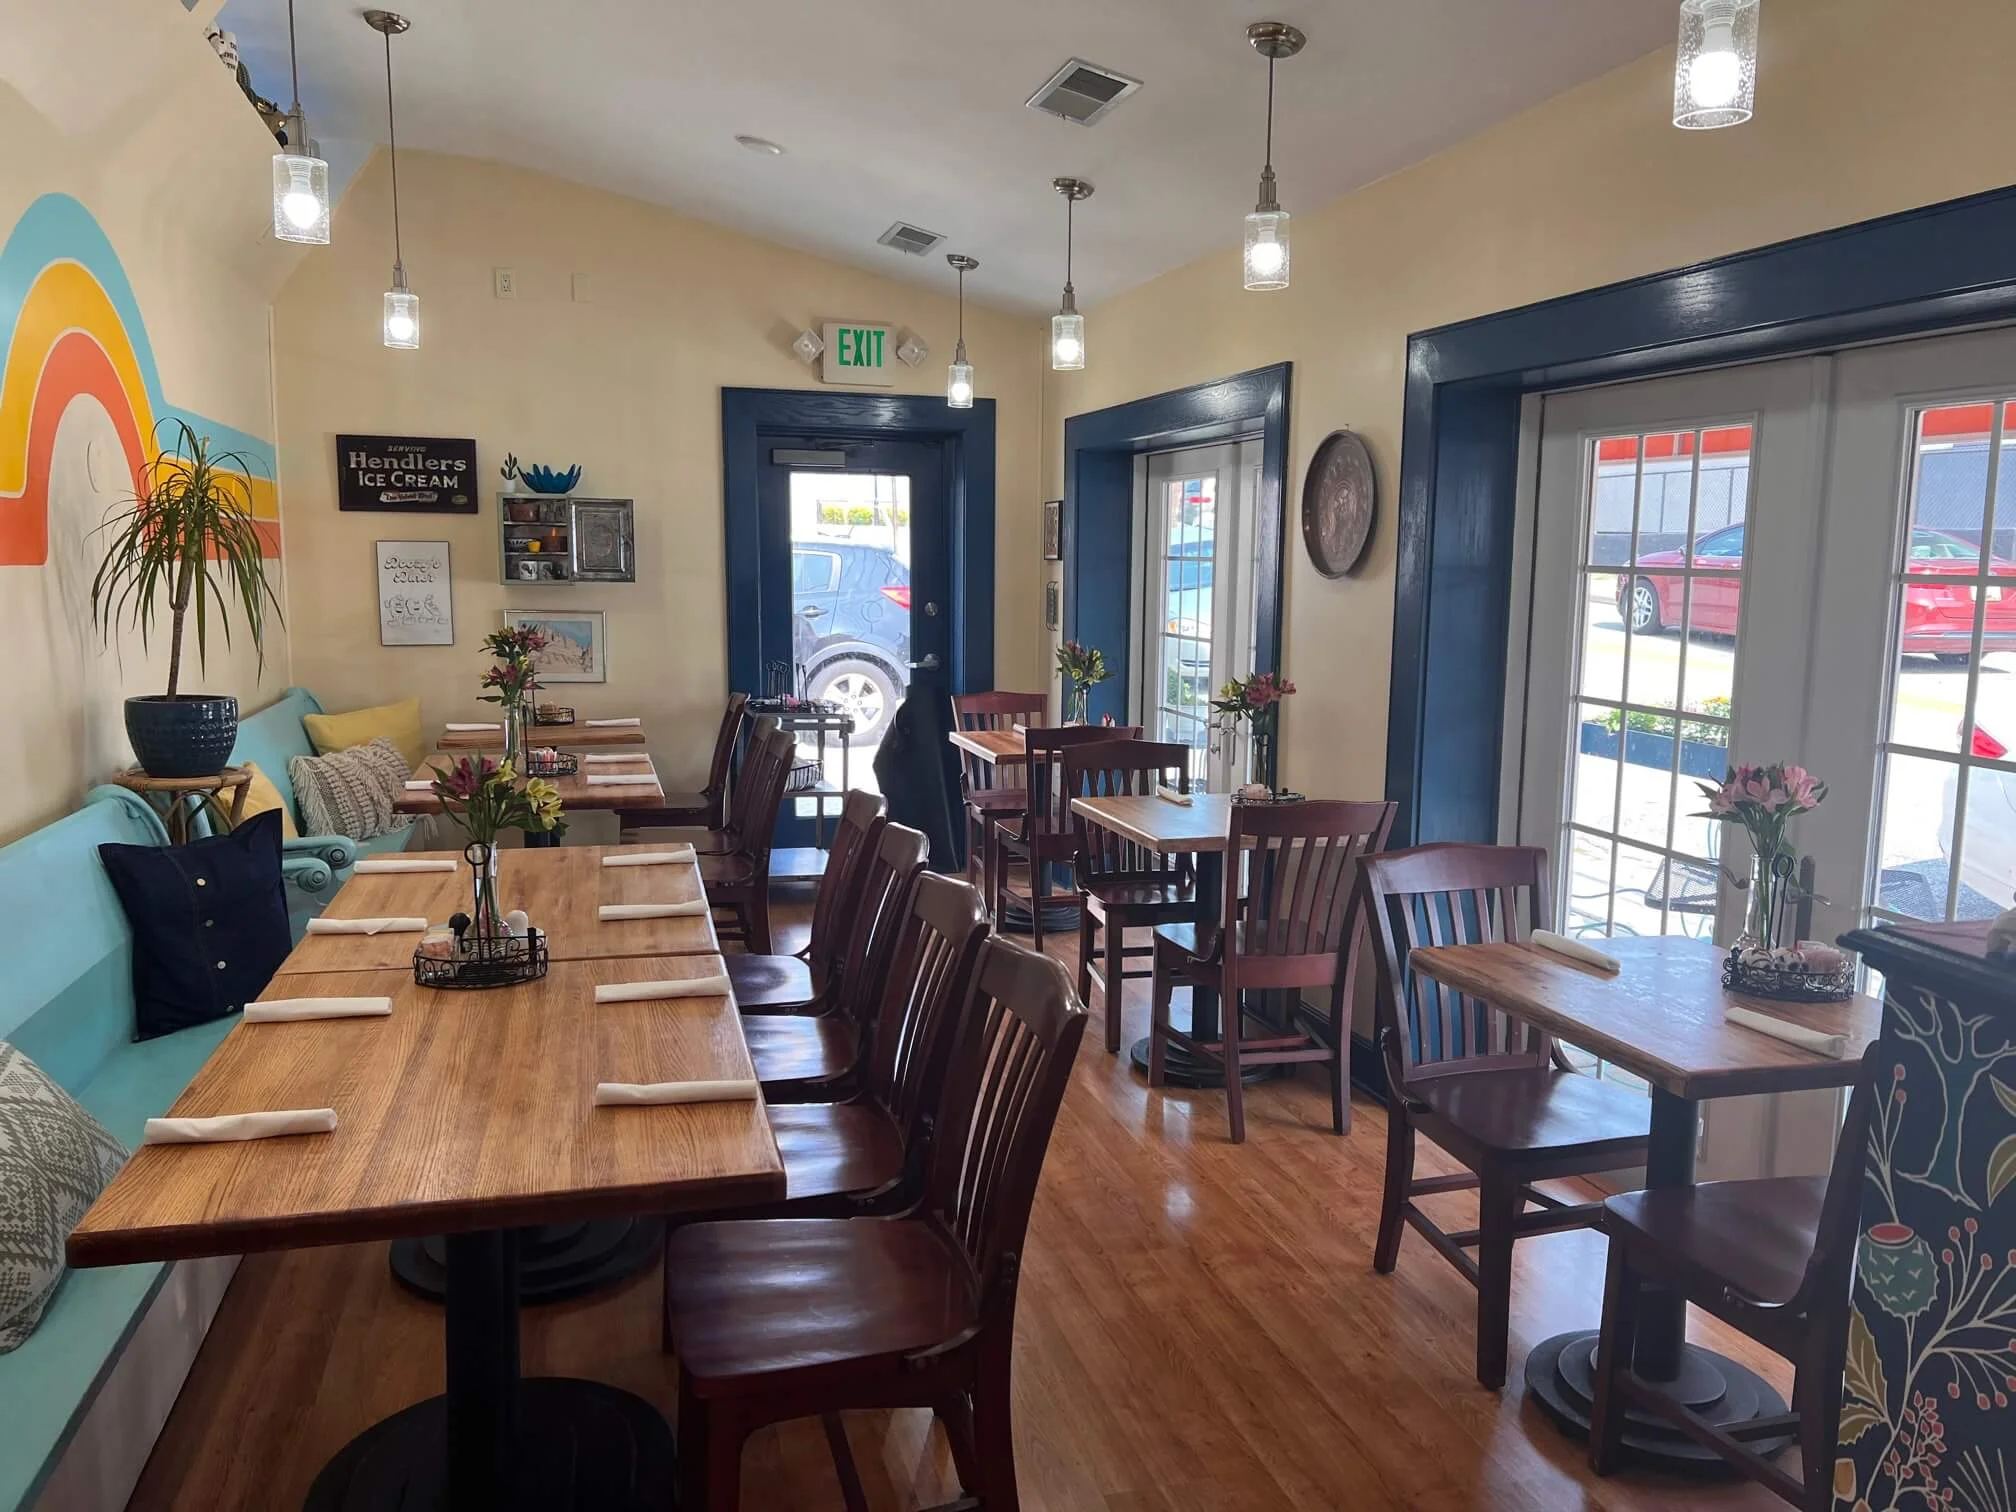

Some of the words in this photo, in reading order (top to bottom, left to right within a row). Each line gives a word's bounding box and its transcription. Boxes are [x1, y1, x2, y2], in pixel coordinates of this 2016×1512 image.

[838, 328, 885, 368] EXIT
[349, 451, 467, 471] Hendlers
[358, 470, 386, 487] ICE
[391, 471, 459, 488] CREAM
